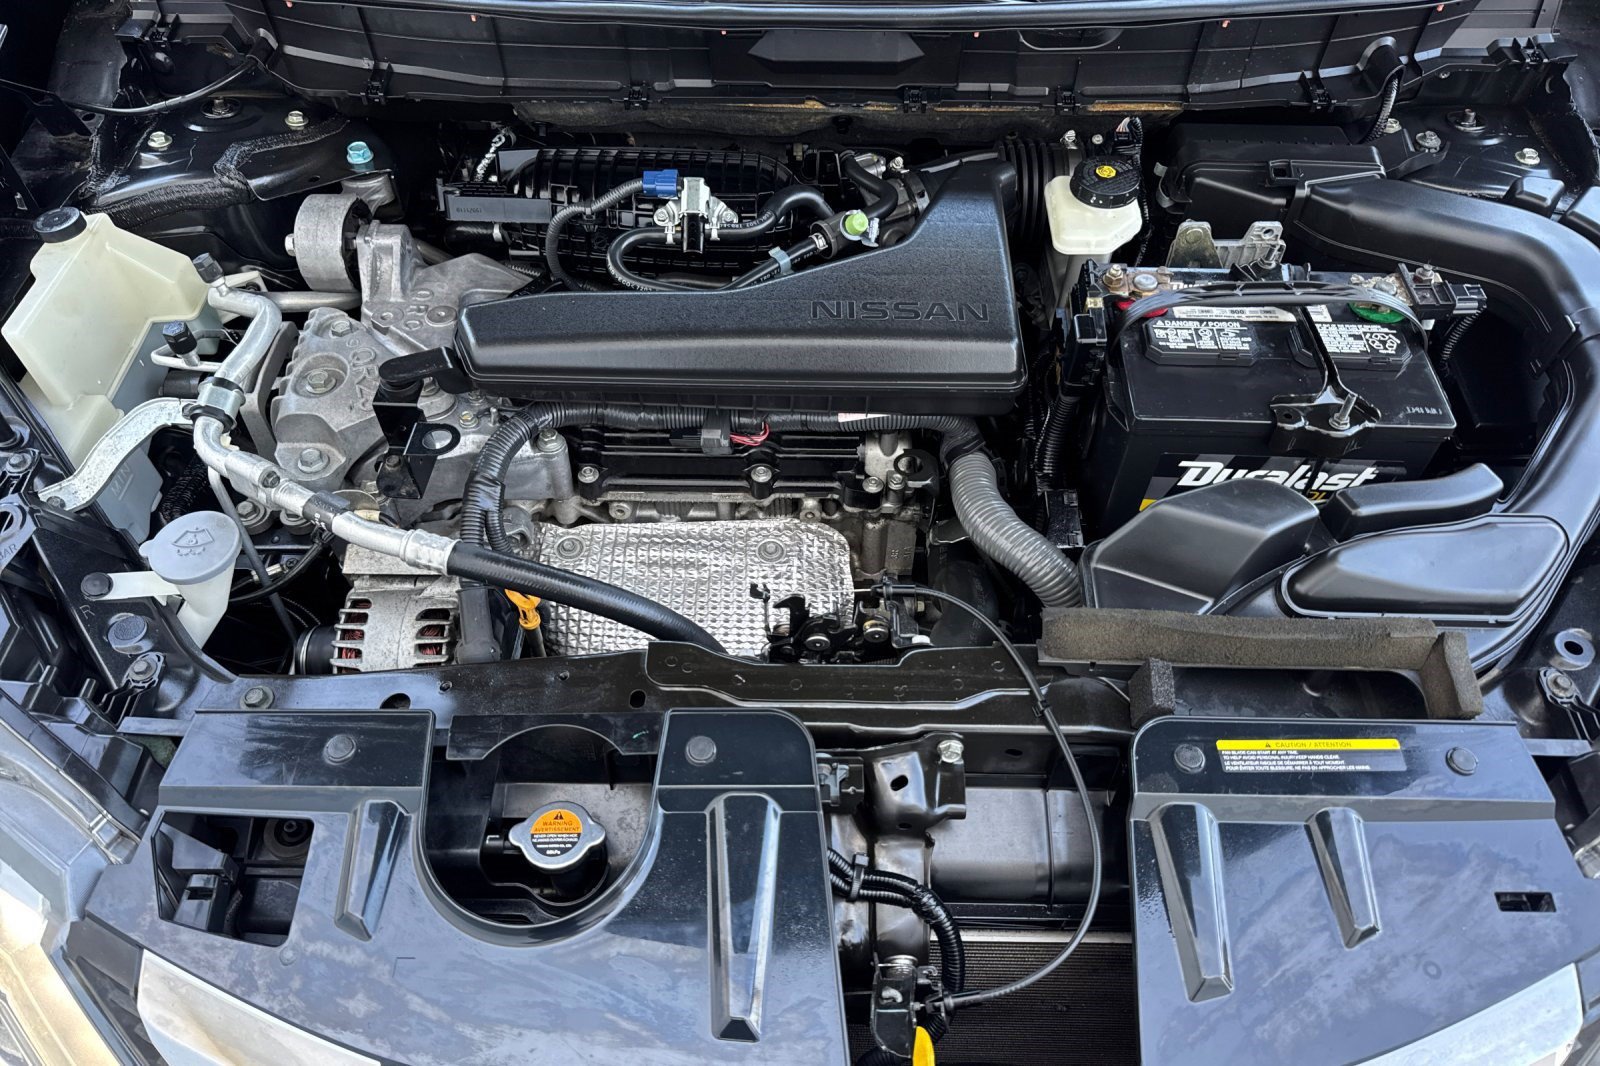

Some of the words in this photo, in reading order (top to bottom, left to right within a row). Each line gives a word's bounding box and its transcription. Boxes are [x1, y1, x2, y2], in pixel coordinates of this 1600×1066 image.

[810, 300, 990, 322] NISSAN
[1164, 320, 1200, 328] DANGER
[110, 461, 131, 497] MIN
[1176, 460, 1379, 491] Duralast
[79, 604, 95, 619] R
